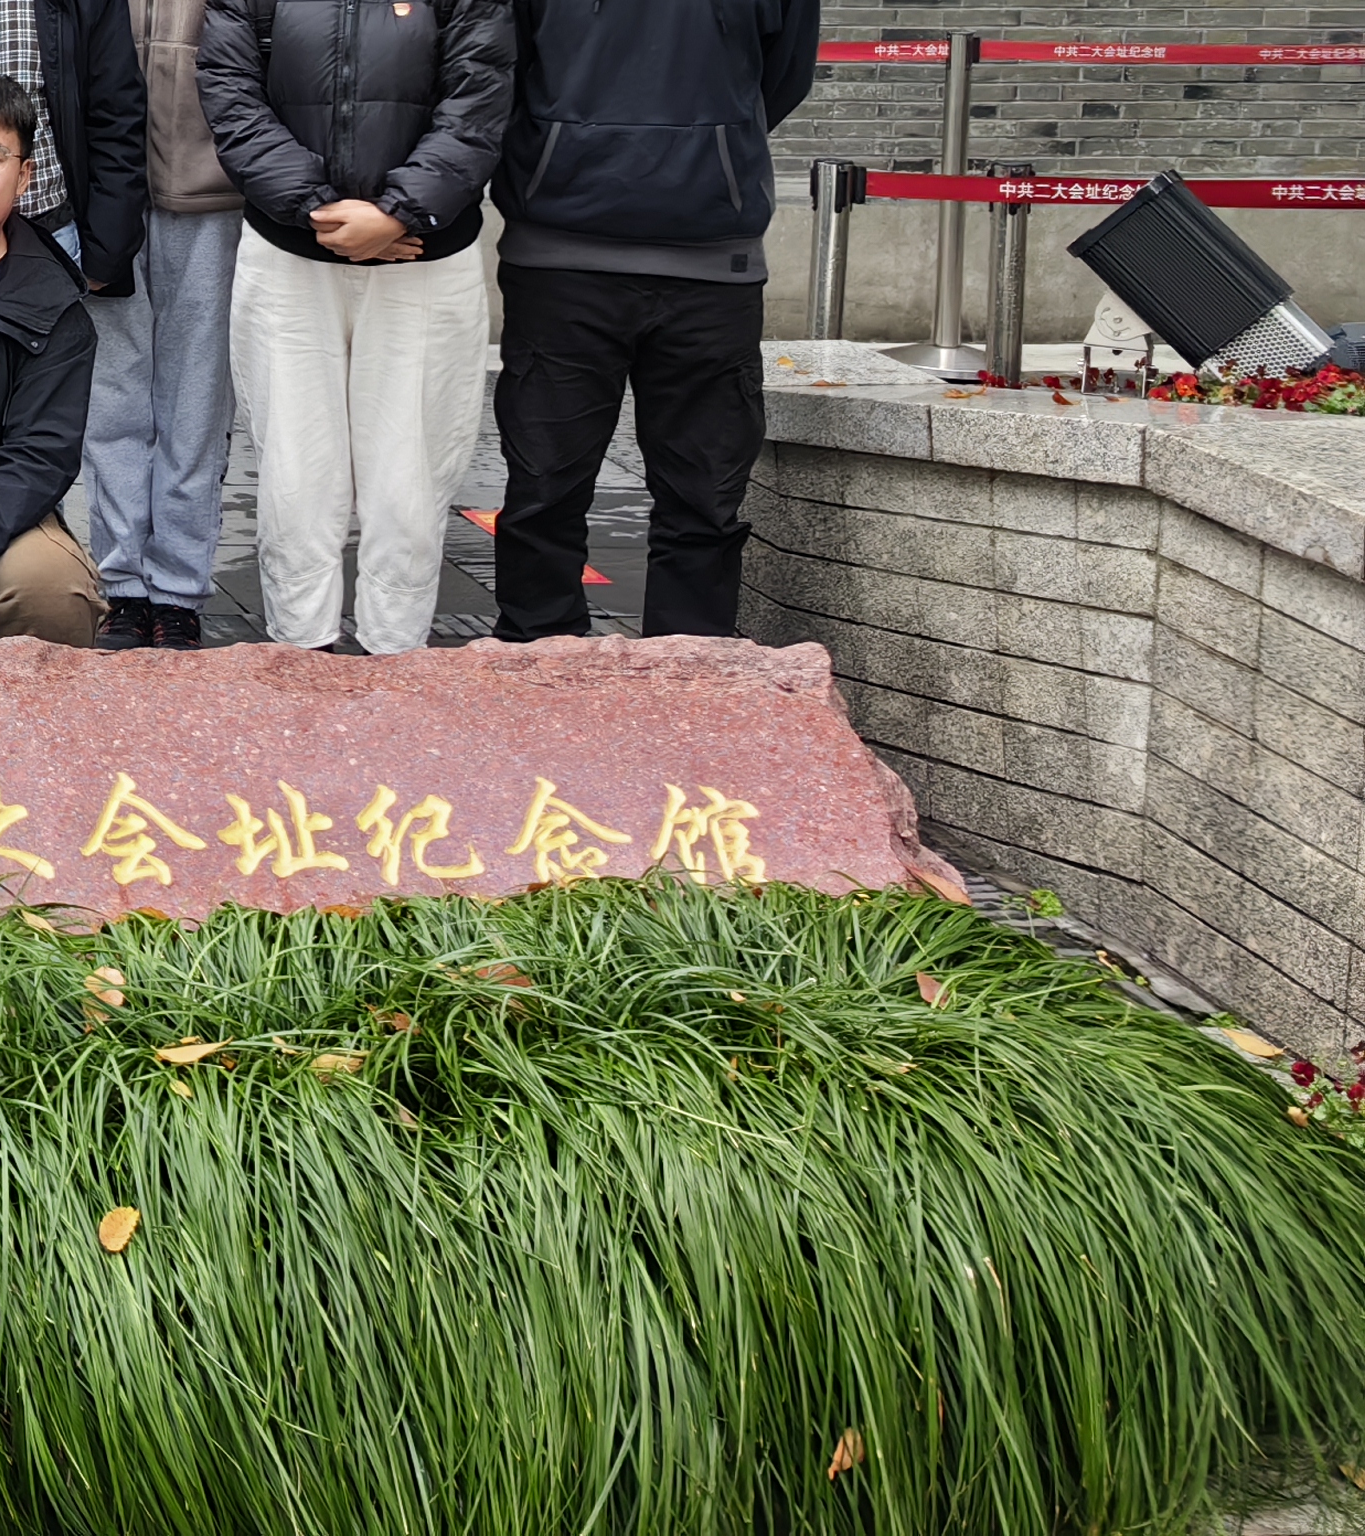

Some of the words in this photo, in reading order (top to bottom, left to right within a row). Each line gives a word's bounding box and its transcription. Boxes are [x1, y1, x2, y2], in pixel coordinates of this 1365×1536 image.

[1053, 44, 1167, 59] 中共二大会址纪念馆
[999, 181, 1140, 201] 中共二大会址纪念
